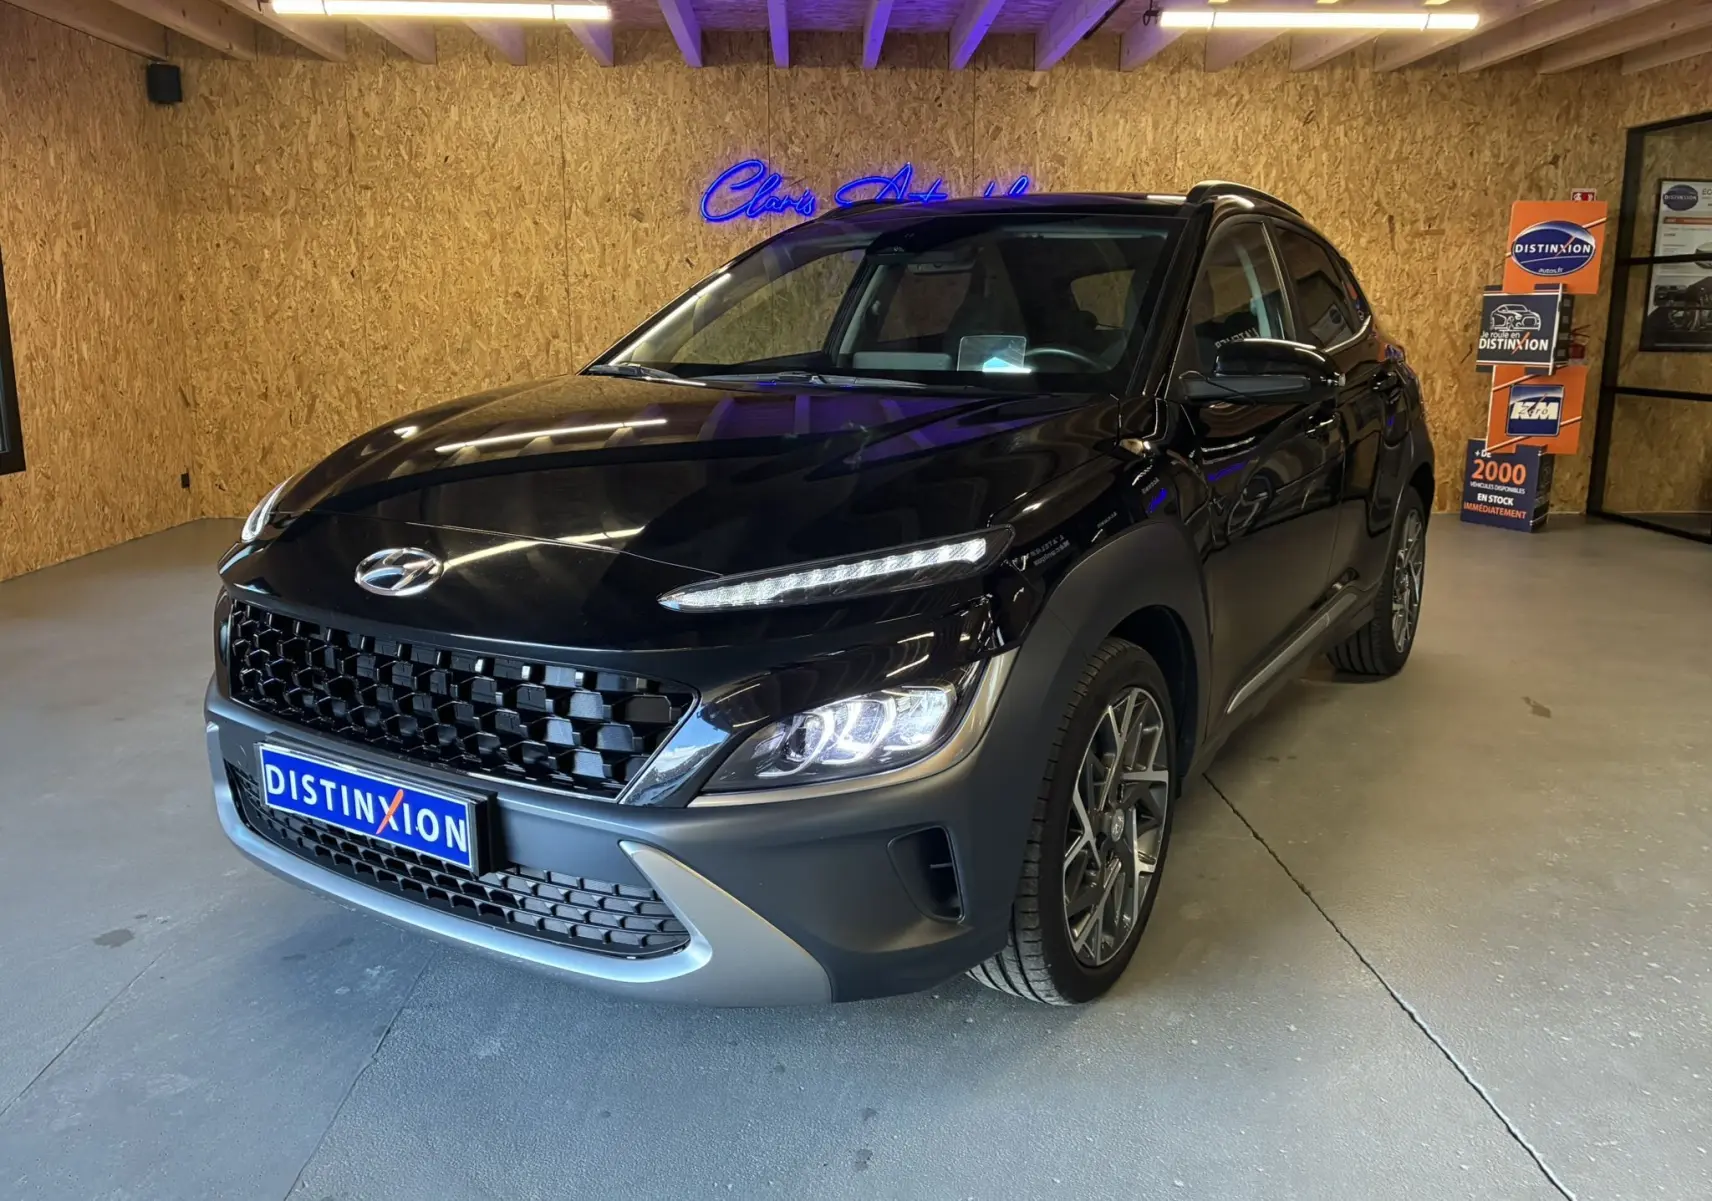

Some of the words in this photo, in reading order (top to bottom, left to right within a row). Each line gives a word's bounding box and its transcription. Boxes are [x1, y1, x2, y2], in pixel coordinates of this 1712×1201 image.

[1515, 240, 1591, 255] DISTINXION
[1490, 331, 1509, 339] roule
[1479, 336, 1549, 353] DISTINXION
[1510, 401, 1559, 420] KM
[1471, 458, 1527, 485] 2000
[1470, 481, 1494, 490] VÉHICULES
[1495, 485, 1526, 495] DISPONIBLES
[1477, 493, 1487, 502] EN
[1488, 494, 1514, 506] STOCK
[1463, 501, 1527, 519] IMMÉDIATEMENT
[265, 763, 467, 853] DISTINXION
